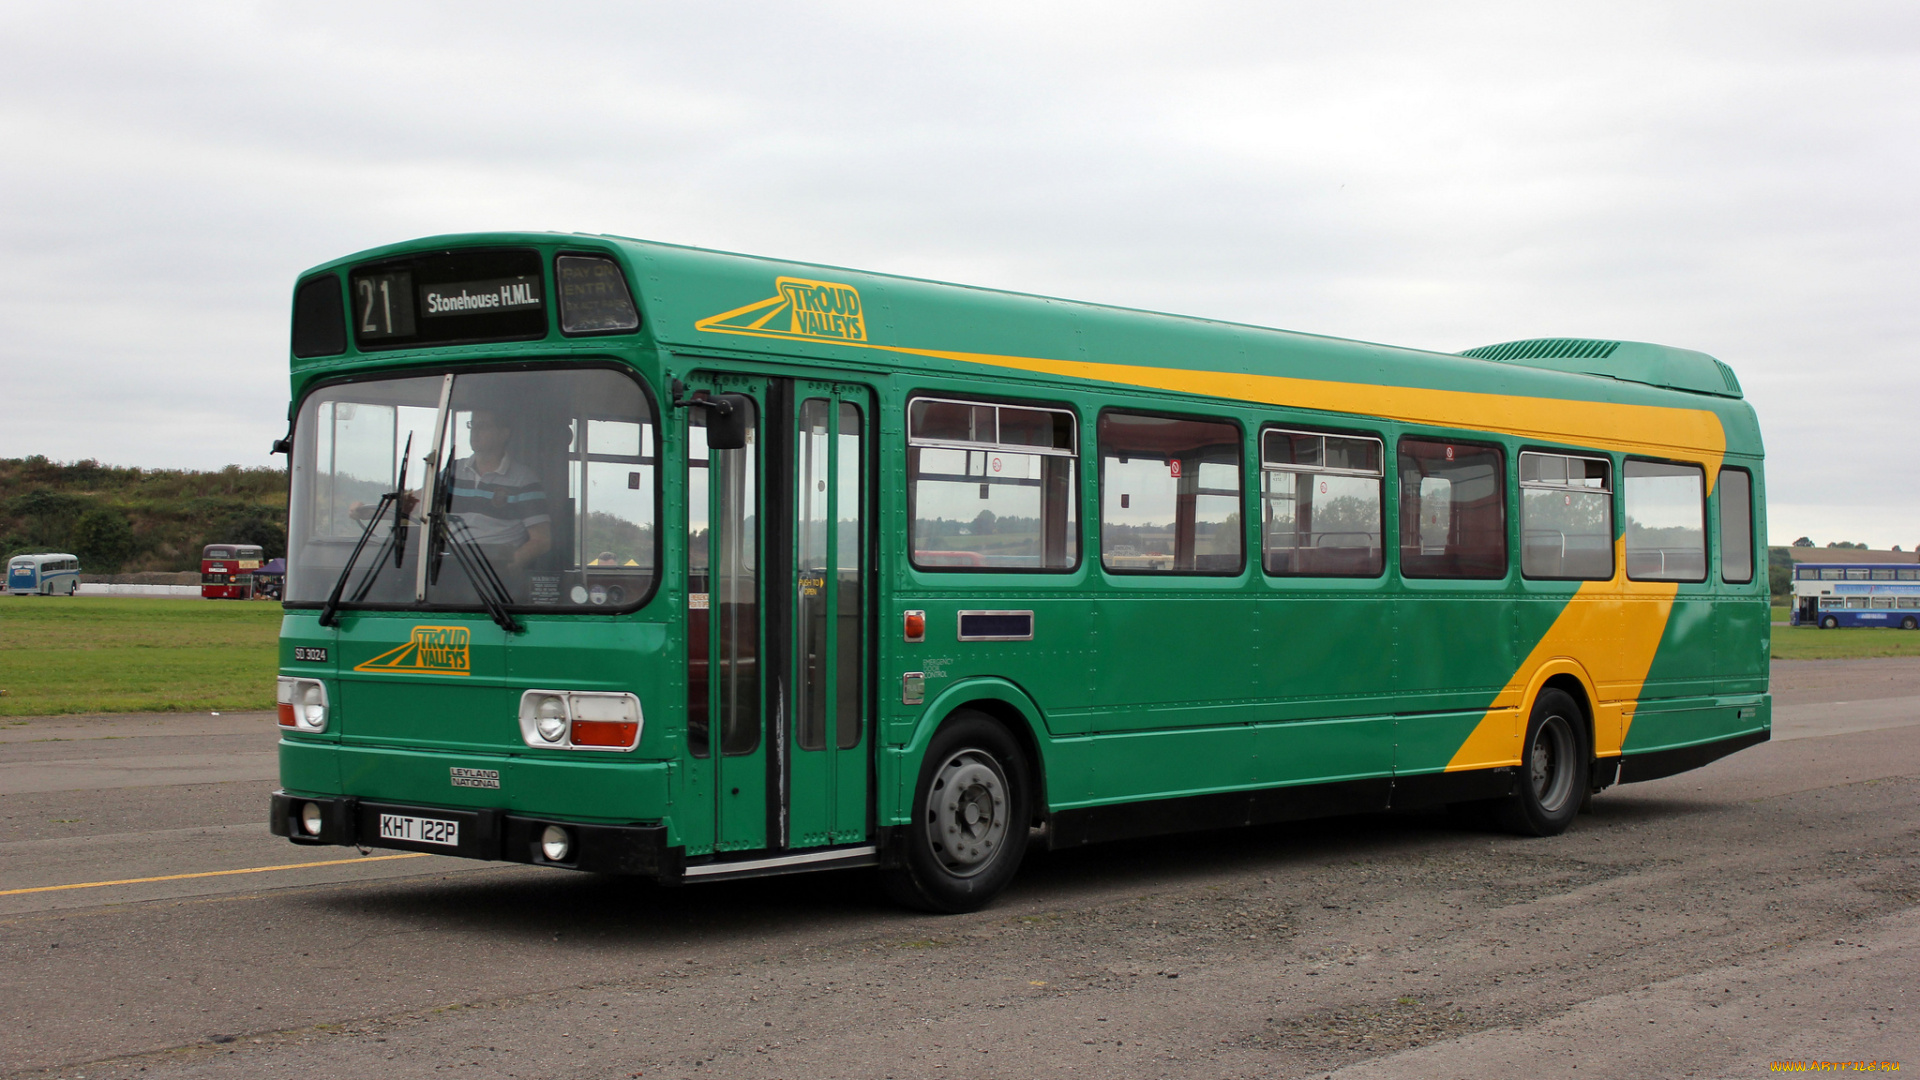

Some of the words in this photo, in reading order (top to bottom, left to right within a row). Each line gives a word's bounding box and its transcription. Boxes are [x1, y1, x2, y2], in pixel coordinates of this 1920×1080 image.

[359, 279, 393, 334] 21
[427, 289, 499, 314] Stonehouse
[500, 283, 540, 307] H.M.L.
[795, 309, 863, 340] VALLEYS
[306, 649, 327, 661] 3024
[420, 650, 467, 669] VALLEYS
[451, 768, 498, 779] LEYLAND
[452, 778, 499, 788] NATIONAL
[383, 816, 414, 838] KHT
[421, 820, 456, 842] 122P
